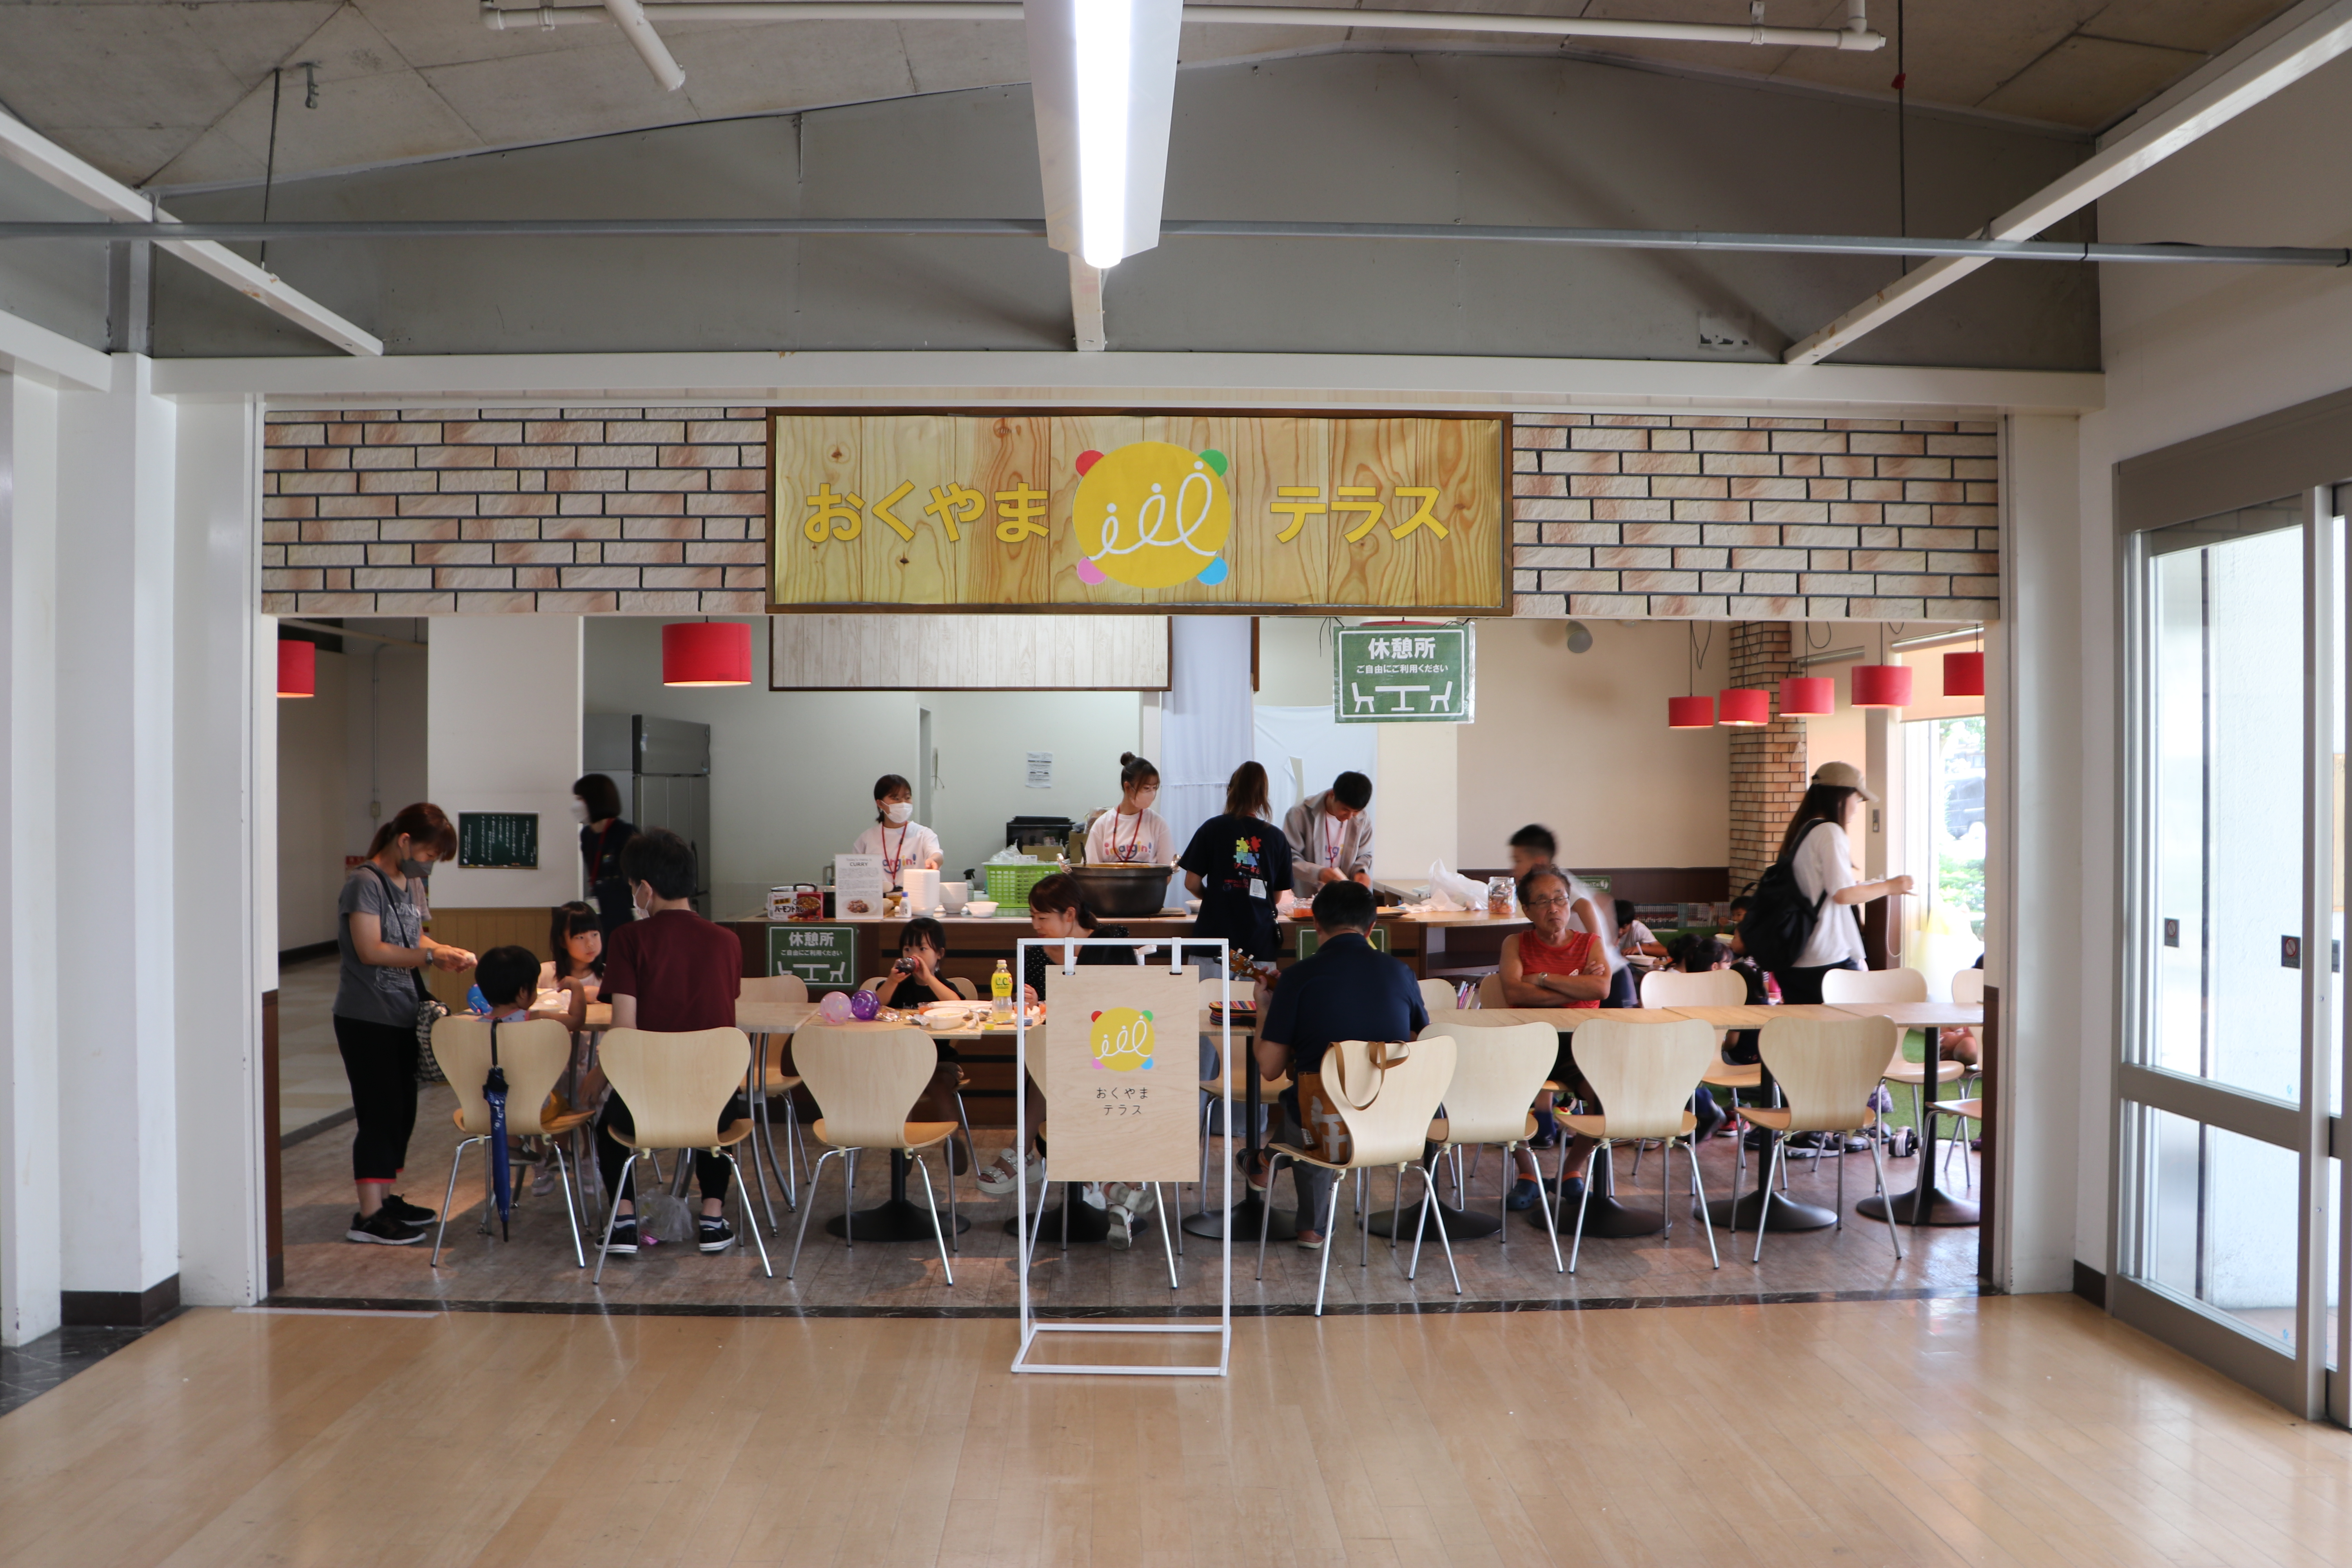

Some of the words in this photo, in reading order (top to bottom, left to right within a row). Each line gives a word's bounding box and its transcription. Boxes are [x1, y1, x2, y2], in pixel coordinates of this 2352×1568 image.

[803, 480, 1050, 544] おくやま
[1270, 485, 1450, 544] テラス
[1368, 636, 1436, 660] 休憩所
[1356, 664, 1448, 674] ご自由にご利用ください
[789, 931, 834, 947] 休憩所
[1096, 1086, 1149, 1099] おくやま
[1103, 1105, 1142, 1116] テラス
